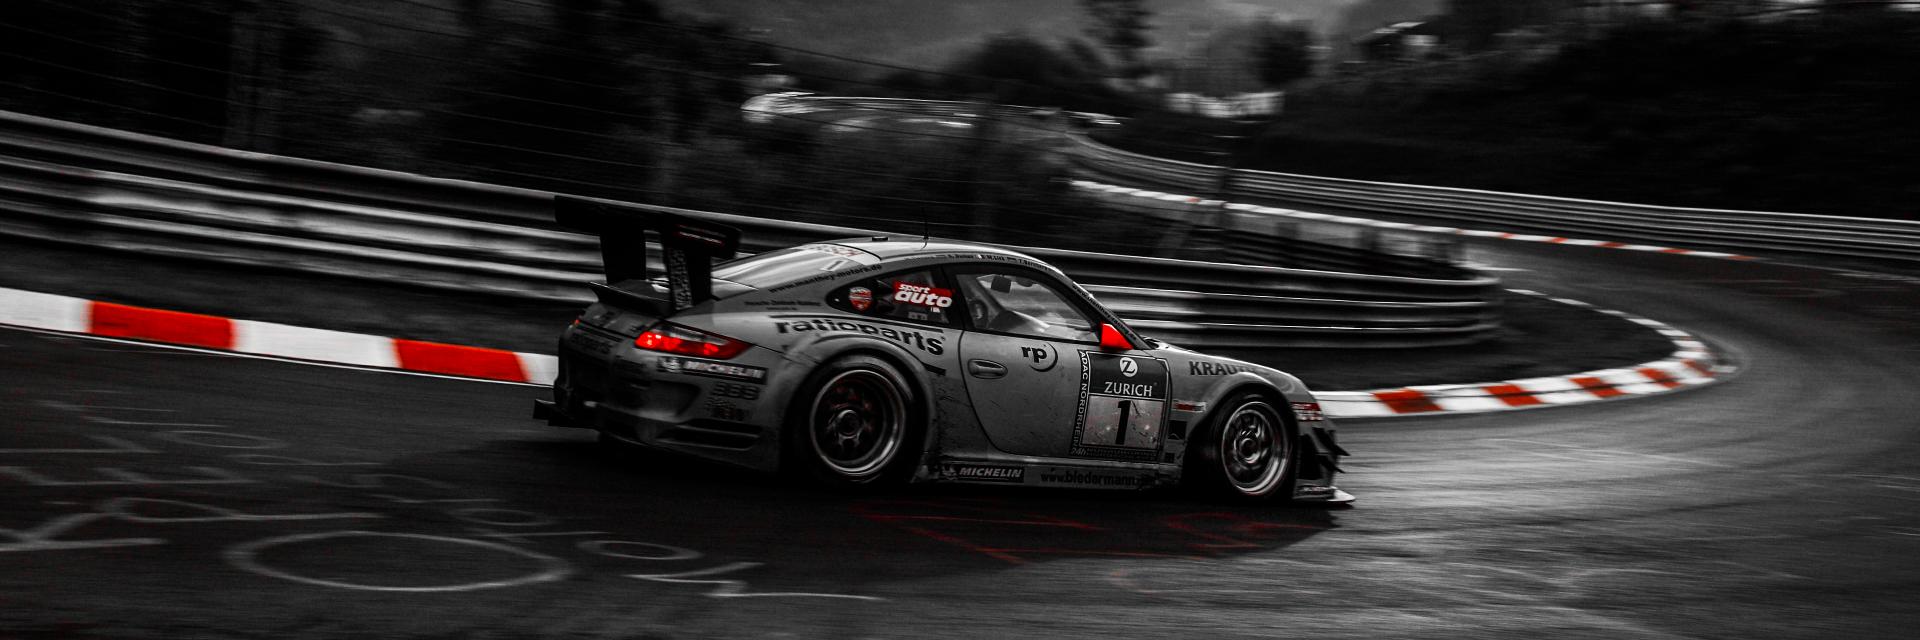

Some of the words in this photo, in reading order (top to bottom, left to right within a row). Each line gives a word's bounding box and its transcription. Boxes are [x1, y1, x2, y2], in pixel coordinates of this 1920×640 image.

[898, 283, 931, 294] sport
[894, 290, 953, 308] auto
[776, 319, 944, 355] ratioparts
[1021, 346, 1048, 363] rp
[685, 360, 766, 379] MICHELIN
[1079, 351, 1088, 380] ADAC
[1103, 381, 1153, 397] ZURICH
[1072, 383, 1088, 447] NORDRHEIN
[1115, 400, 1132, 445] 1
[958, 467, 1023, 478] MICHELIN
